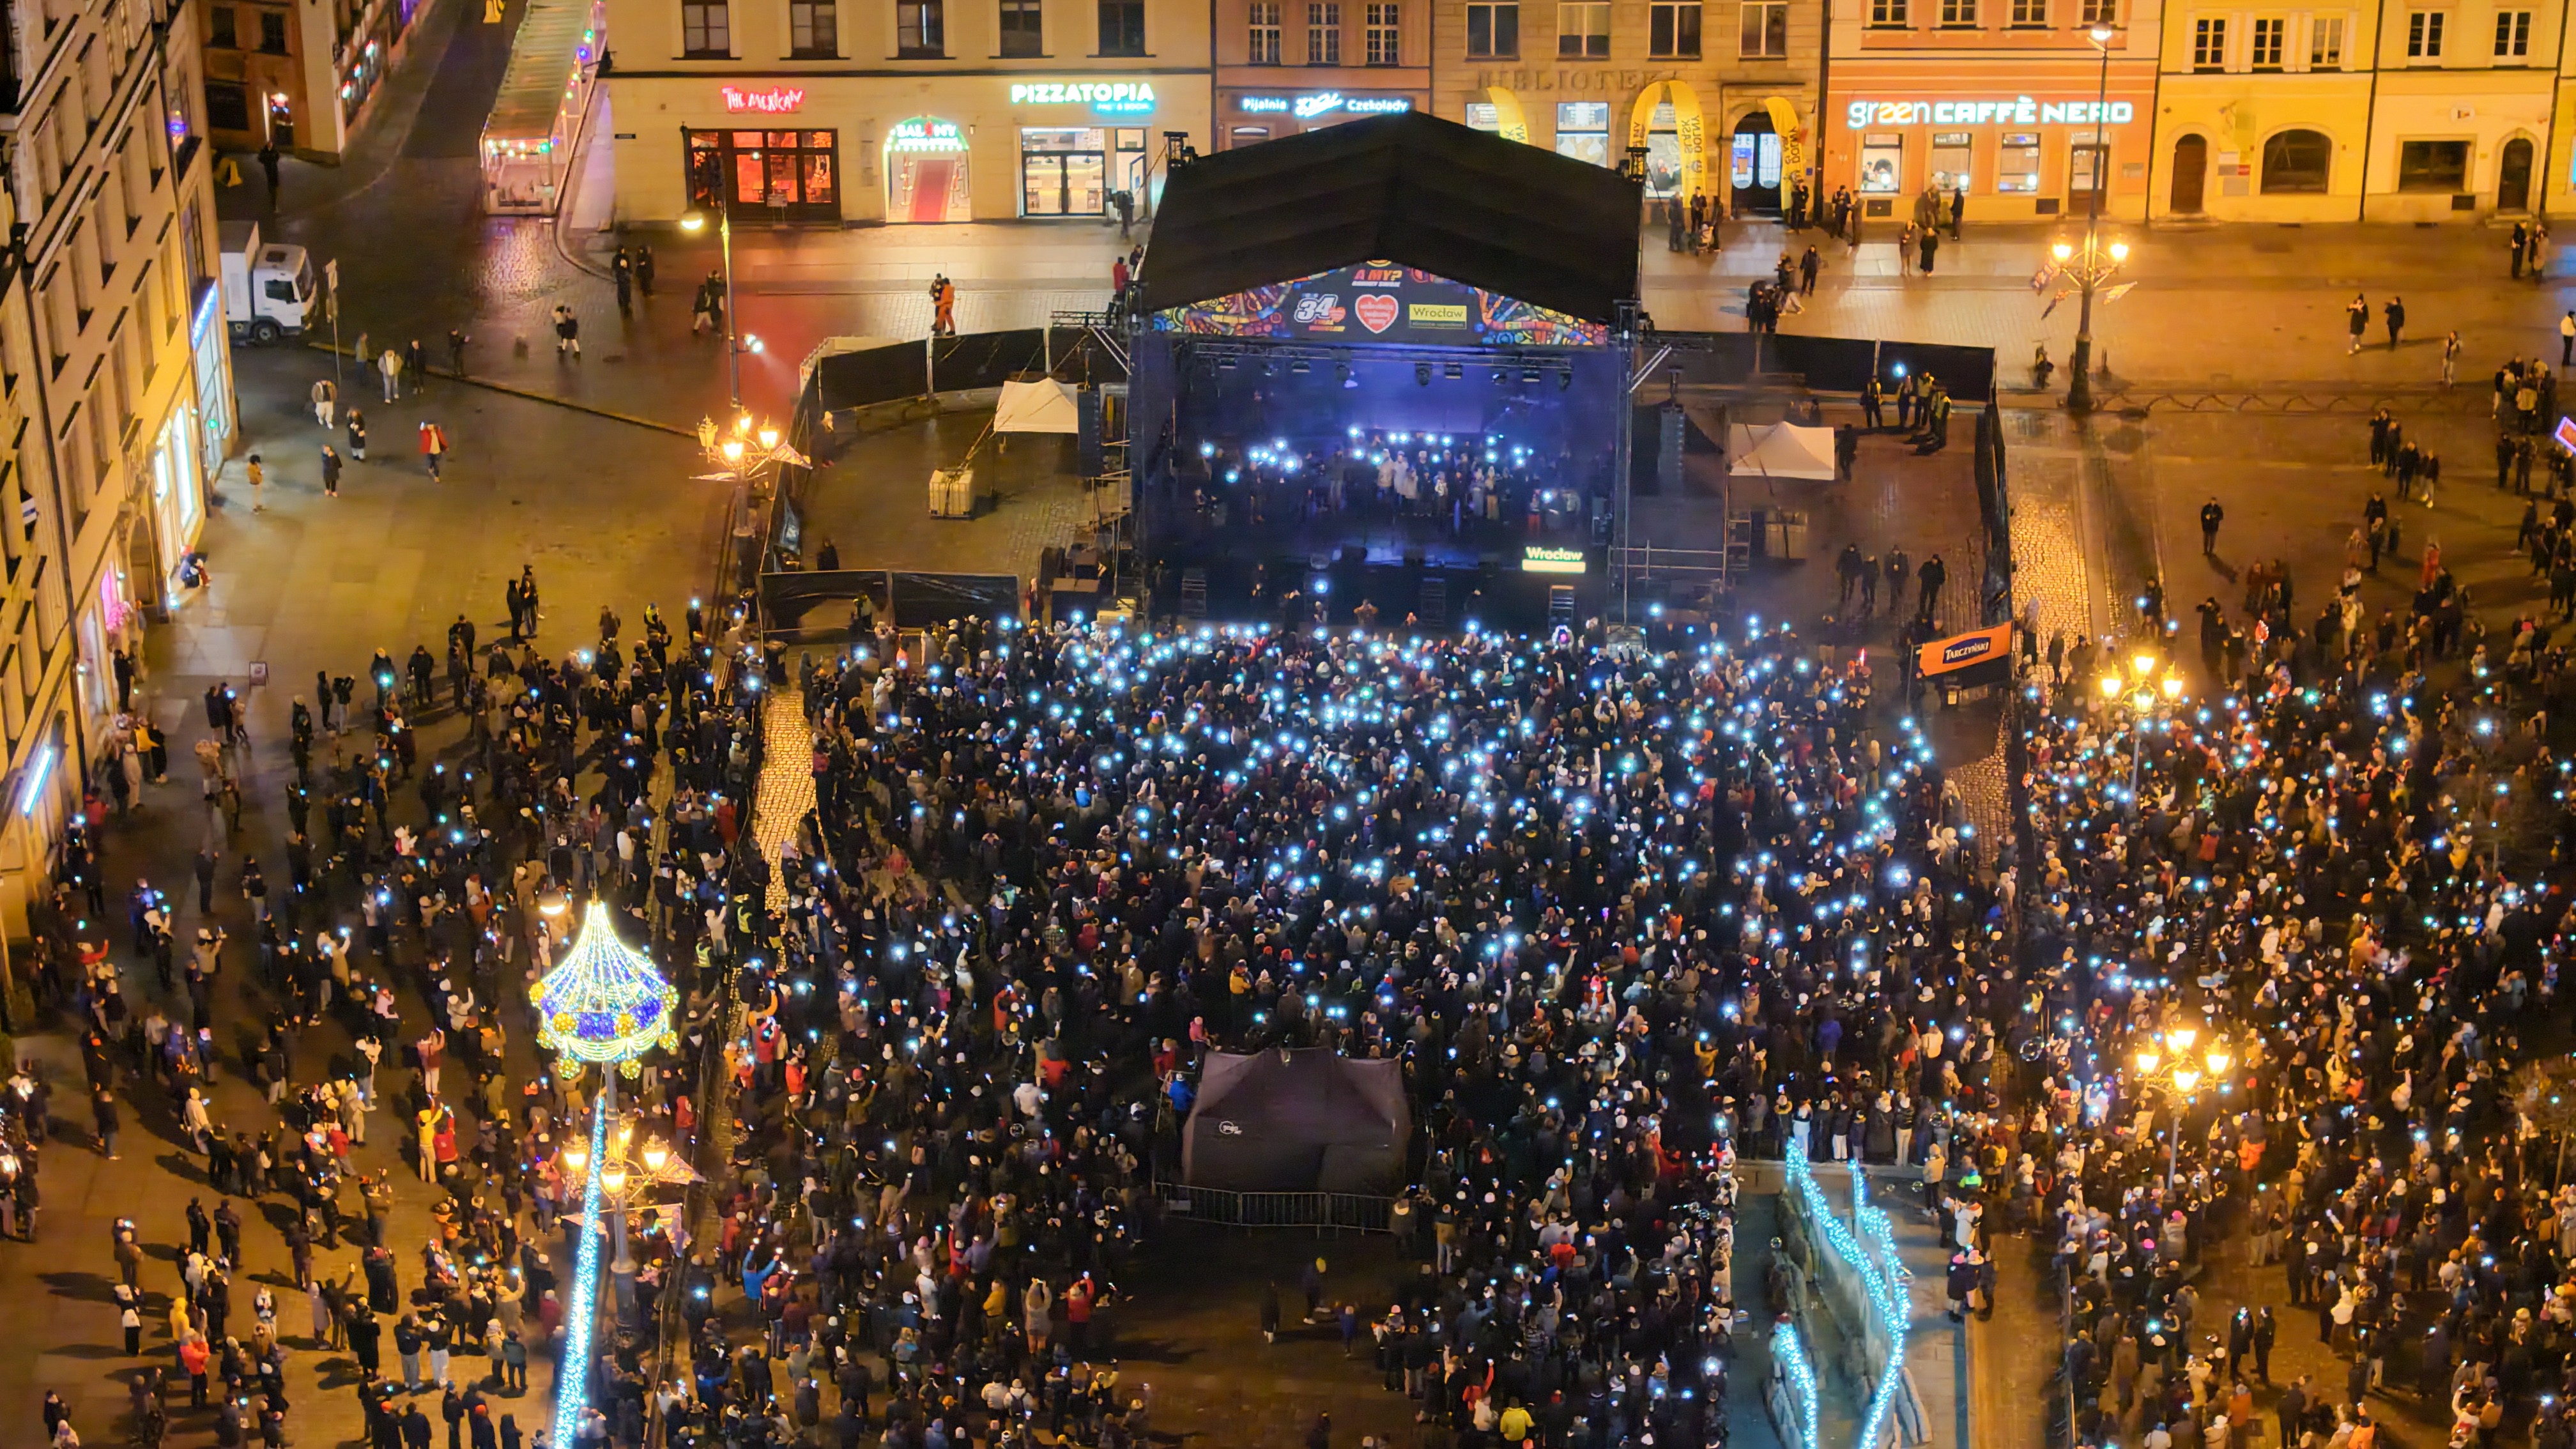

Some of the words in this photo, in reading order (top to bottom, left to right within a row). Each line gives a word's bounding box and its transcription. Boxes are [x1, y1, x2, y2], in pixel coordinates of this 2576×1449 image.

[722, 87, 746, 109] THE
[748, 86, 803, 111] MEXICAN
[1011, 83, 1154, 103] PIZZATOPIA
[1243, 98, 1287, 112] Pijalnia
[1347, 99, 1409, 113] Czekolady
[1848, 100, 1929, 128] green
[1935, 95, 2036, 124] CAFFÈ
[2041, 102, 2133, 124] NERO
[1354, 270, 1365, 280] A
[1368, 270, 1402, 280] MY?
[1294, 294, 1338, 323] 34
[1413, 307, 1463, 318] Wrocław
[1525, 546, 1583, 560] Wrocław
[1945, 641, 1989, 661] TARCZYŃSKI
